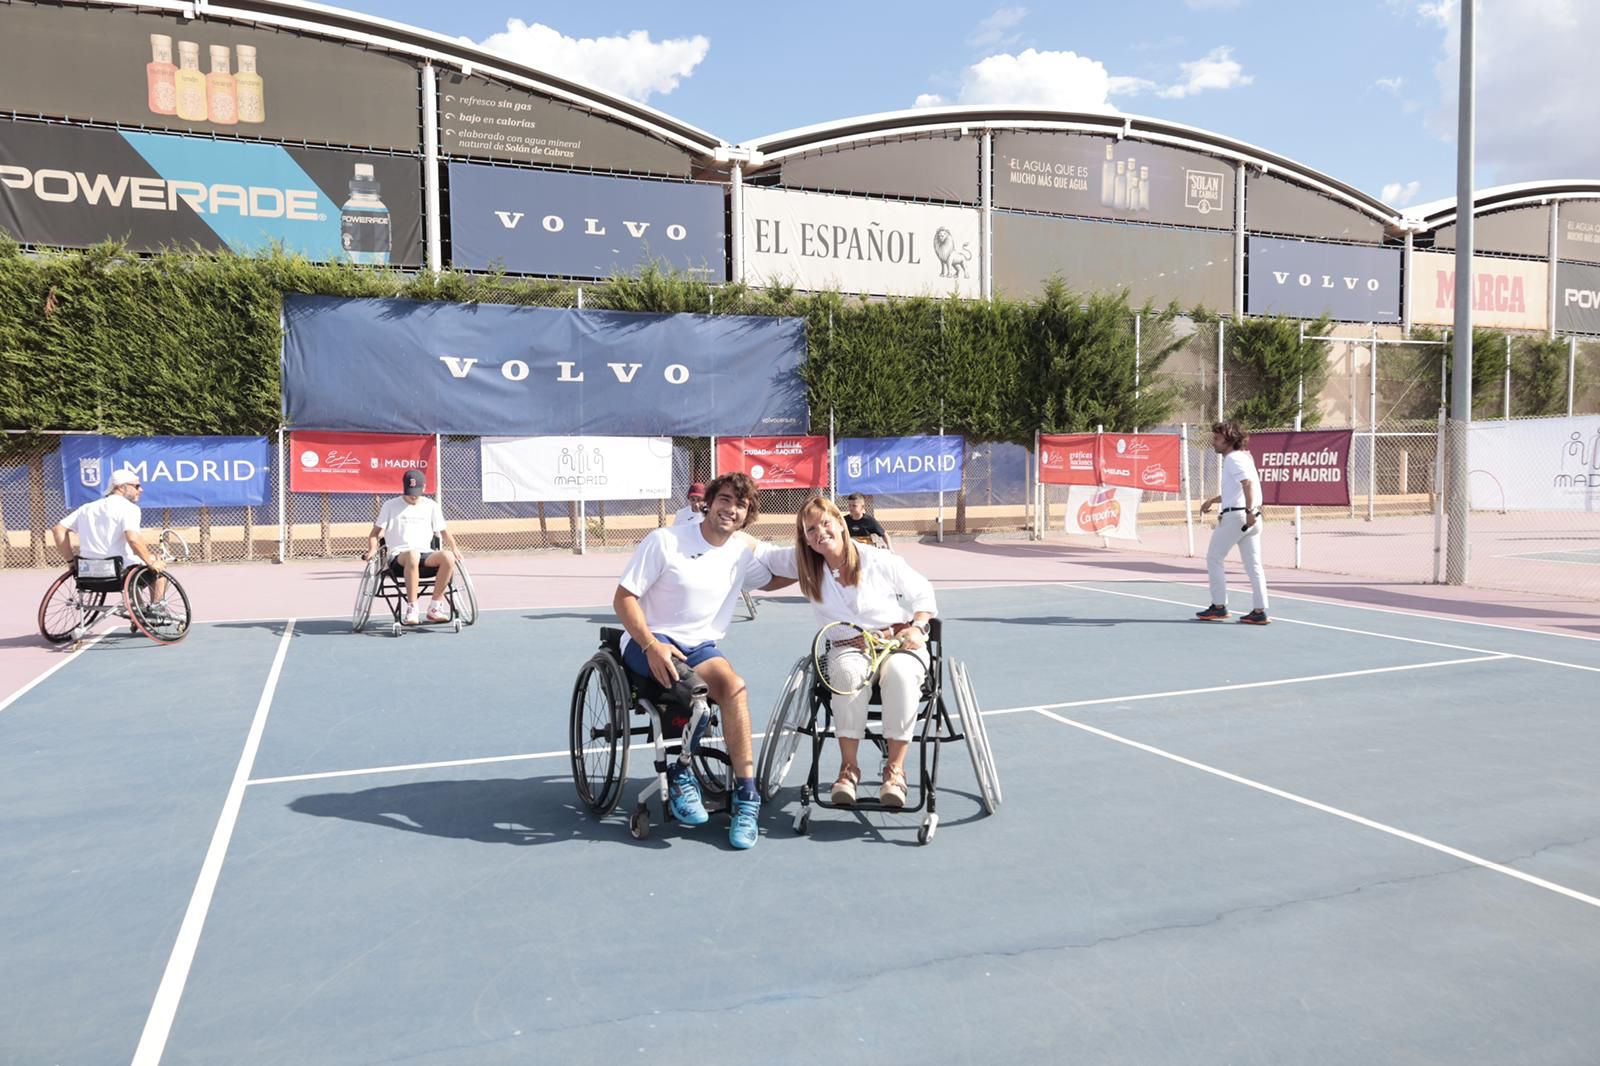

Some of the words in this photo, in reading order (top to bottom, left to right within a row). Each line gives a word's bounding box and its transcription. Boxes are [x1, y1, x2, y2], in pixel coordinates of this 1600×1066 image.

[459, 96, 496, 107] refresco
[498, 98, 513, 109] sin
[514, 102, 532, 112] gas
[459, 112, 482, 125] bajo
[483, 116, 494, 124] en
[496, 117, 536, 129] calorías
[458, 128, 505, 142] elaborado
[507, 134, 523, 143] con
[525, 136, 547, 146] agua
[548, 137, 582, 149] mineral
[458, 139, 493, 150] natural
[494, 142, 504, 151] de
[505, 143, 530, 154] Solán
[531, 145, 543, 155] de
[544, 147, 575, 158] Cabras
[1010, 158, 1021, 171] EL
[1023, 160, 1052, 173] AGUA
[1054, 163, 1076, 176] QUE
[1077, 165, 1089, 177] ES
[1010, 172, 1036, 185] MUCHO
[1037, 172, 1052, 187] MÁS
[1053, 176, 1068, 189] QUE
[1068, 178, 1088, 191] AGUA
[494, 210, 687, 241] VOLVO
[755, 218, 788, 254] EL
[800, 221, 921, 265] ESPAÑOL
[1273, 270, 1380, 291] VOLVO
[440, 356, 690, 385] VOLVO
[384, 459, 428, 469] MADRID
[875, 454, 956, 474] MADRID
[1262, 447, 1338, 466] FEDERACIÓN
[124, 460, 256, 482] MADRID
[554, 475, 608, 486] MADRID
[1258, 468, 1290, 483] TENIS
[1292, 467, 1341, 483] MADRID
